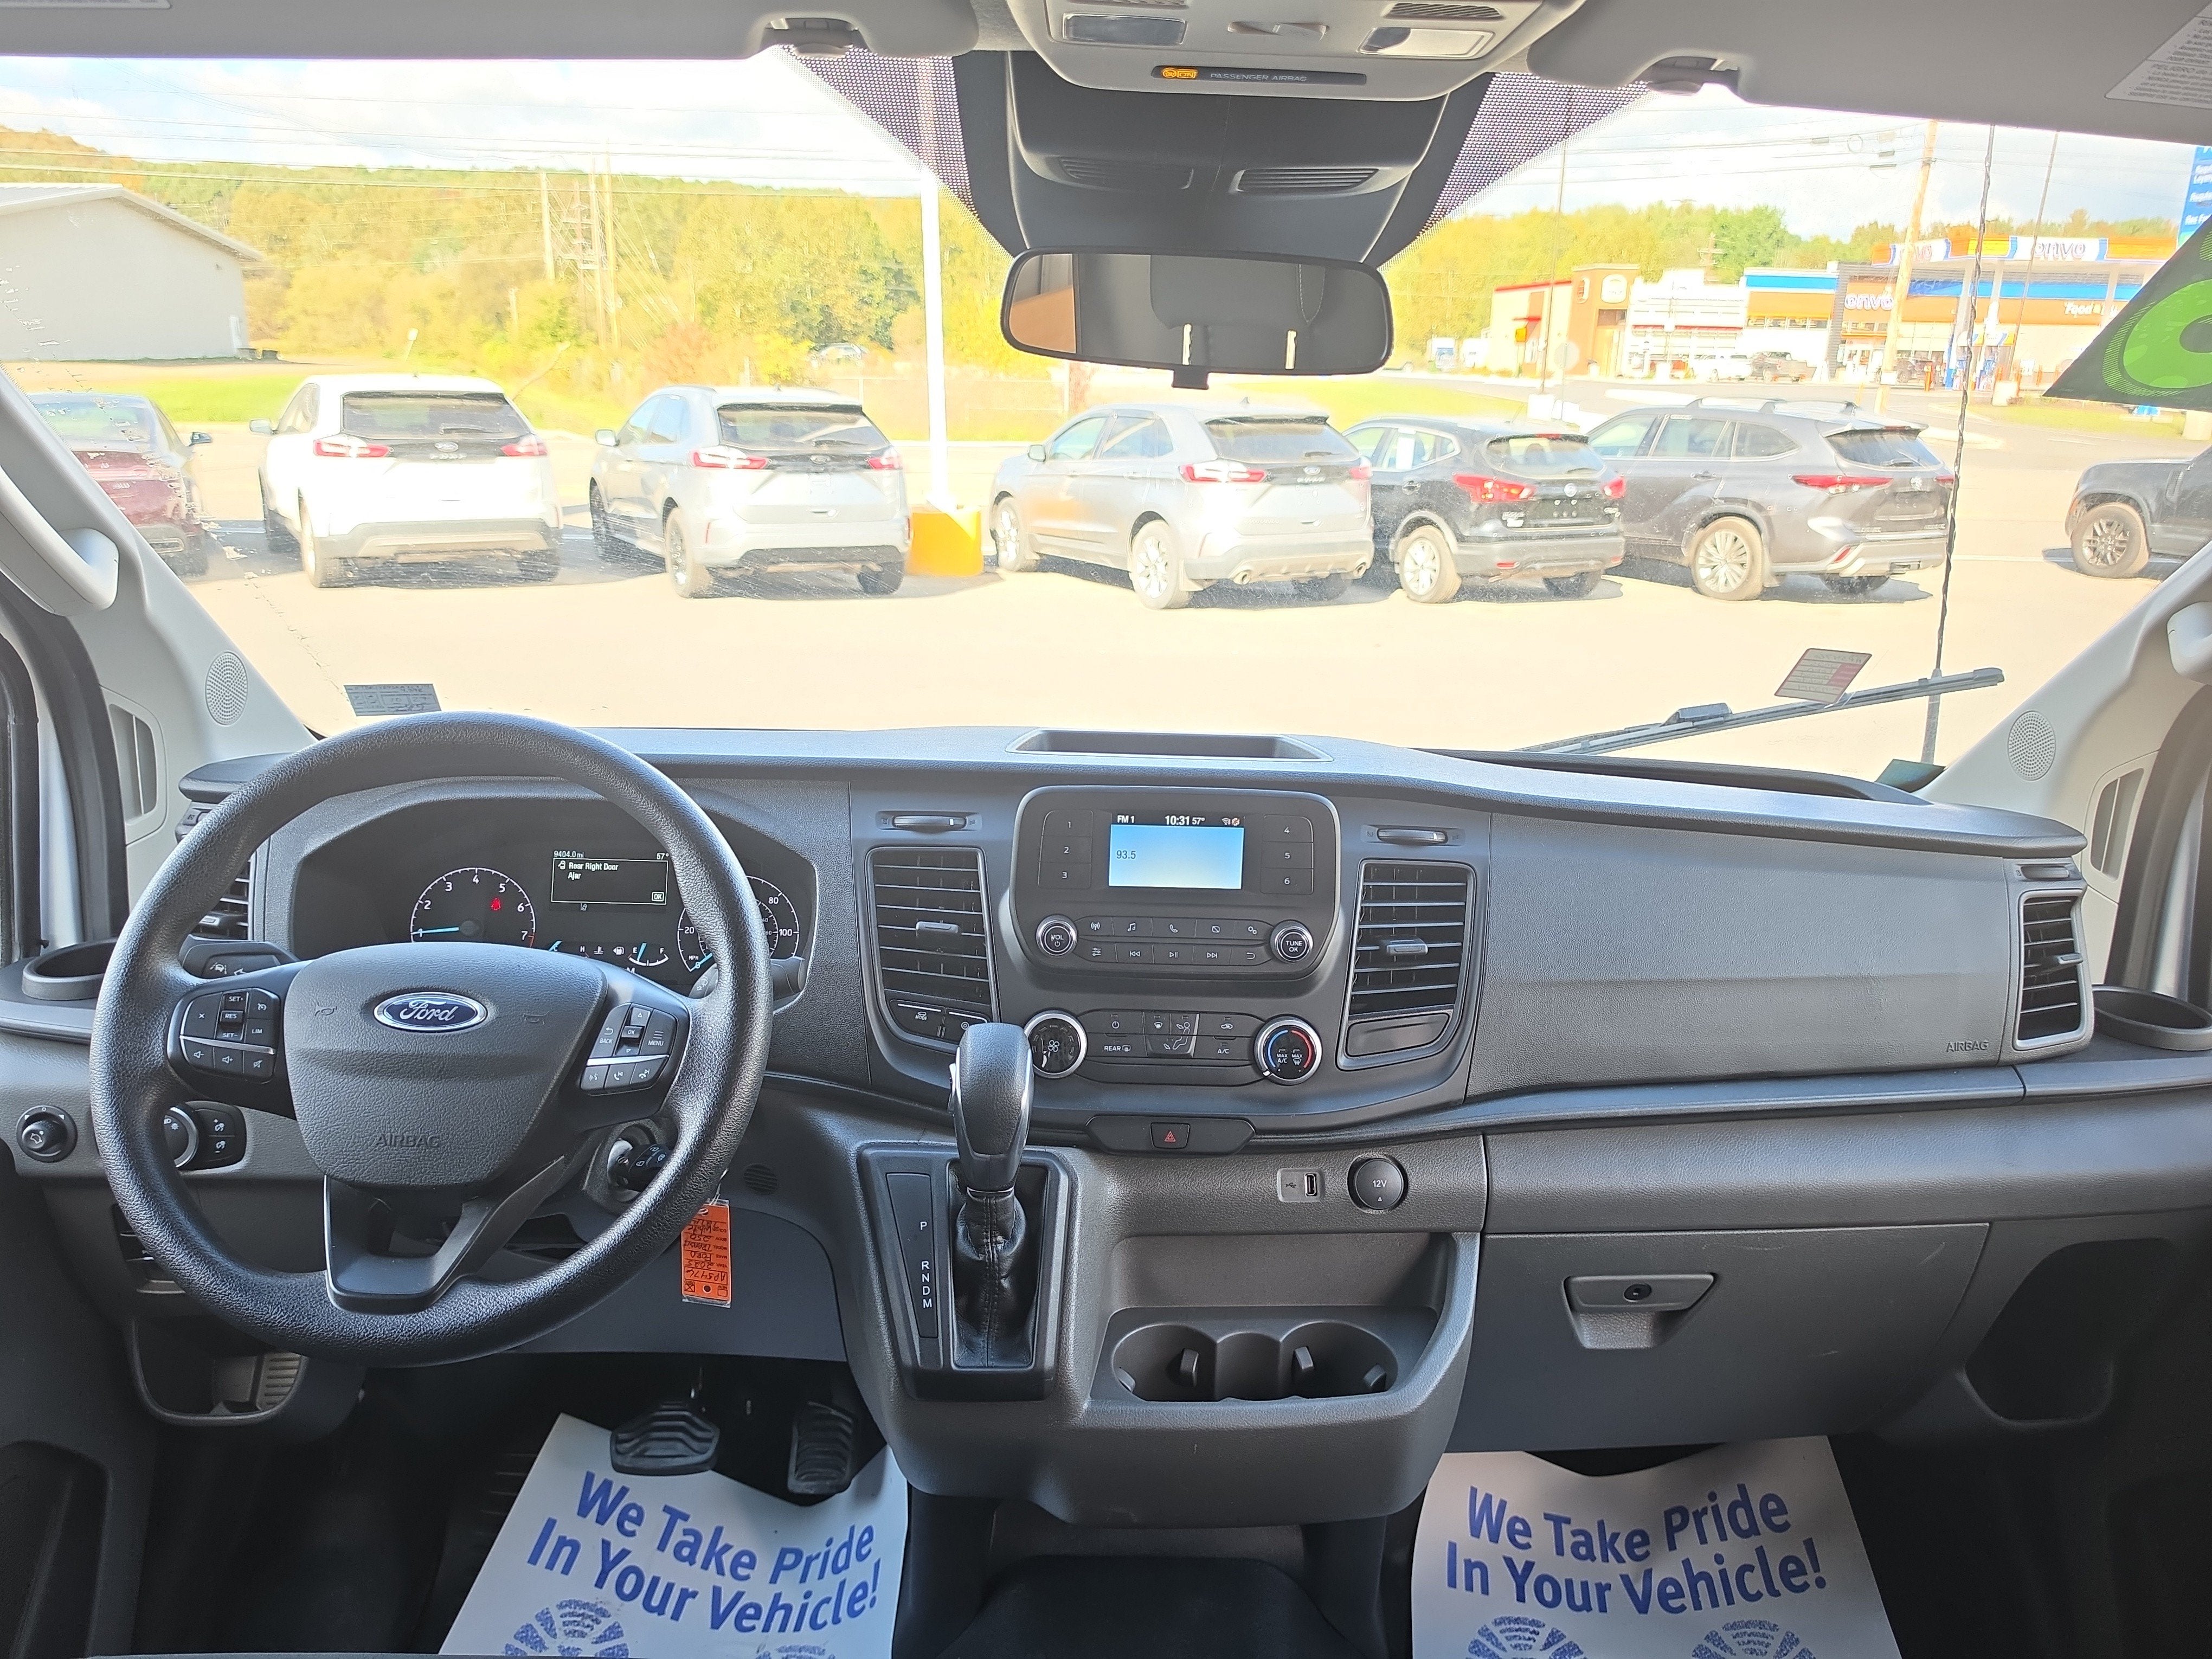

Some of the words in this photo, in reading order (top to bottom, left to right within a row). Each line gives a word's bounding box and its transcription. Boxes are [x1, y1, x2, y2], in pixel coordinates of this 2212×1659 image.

[1165, 815, 1189, 825] 10:31
[1116, 850, 1136, 859] 93.5
[586, 863, 602, 872] Right
[473, 874, 479, 884] 4
[568, 872, 581, 880] Ajar
[445, 882, 453, 891] 3
[499, 884, 505, 893] 5
[424, 901, 431, 910] 2
[517, 903, 524, 912] 6
[521, 931, 528, 940] 7
[400, 999, 459, 1021] Ford
[1946, 1040, 1990, 1052] AIRBAG
[377, 1133, 440, 1148] AIRBAG
[920, 1221, 927, 1230] P
[922, 1261, 930, 1270] R
[922, 1273, 930, 1283] N
[923, 1286, 930, 1295] D
[923, 1298, 932, 1308] M
[576, 1470, 646, 1538] We
[656, 1504, 758, 1582] Take
[768, 1523, 874, 1585] Pride
[1469, 1486, 1533, 1551] We
[1543, 1511, 1651, 1565] Take
[1663, 1483, 1792, 1552] Pride
[527, 1516, 582, 1576] In
[593, 1538, 699, 1623] Your
[709, 1557, 882, 1634] Vehicle!
[1446, 1540, 1490, 1597] In
[1503, 1554, 1612, 1614] Your
[1620, 1538, 1827, 1615] Vehicle!
